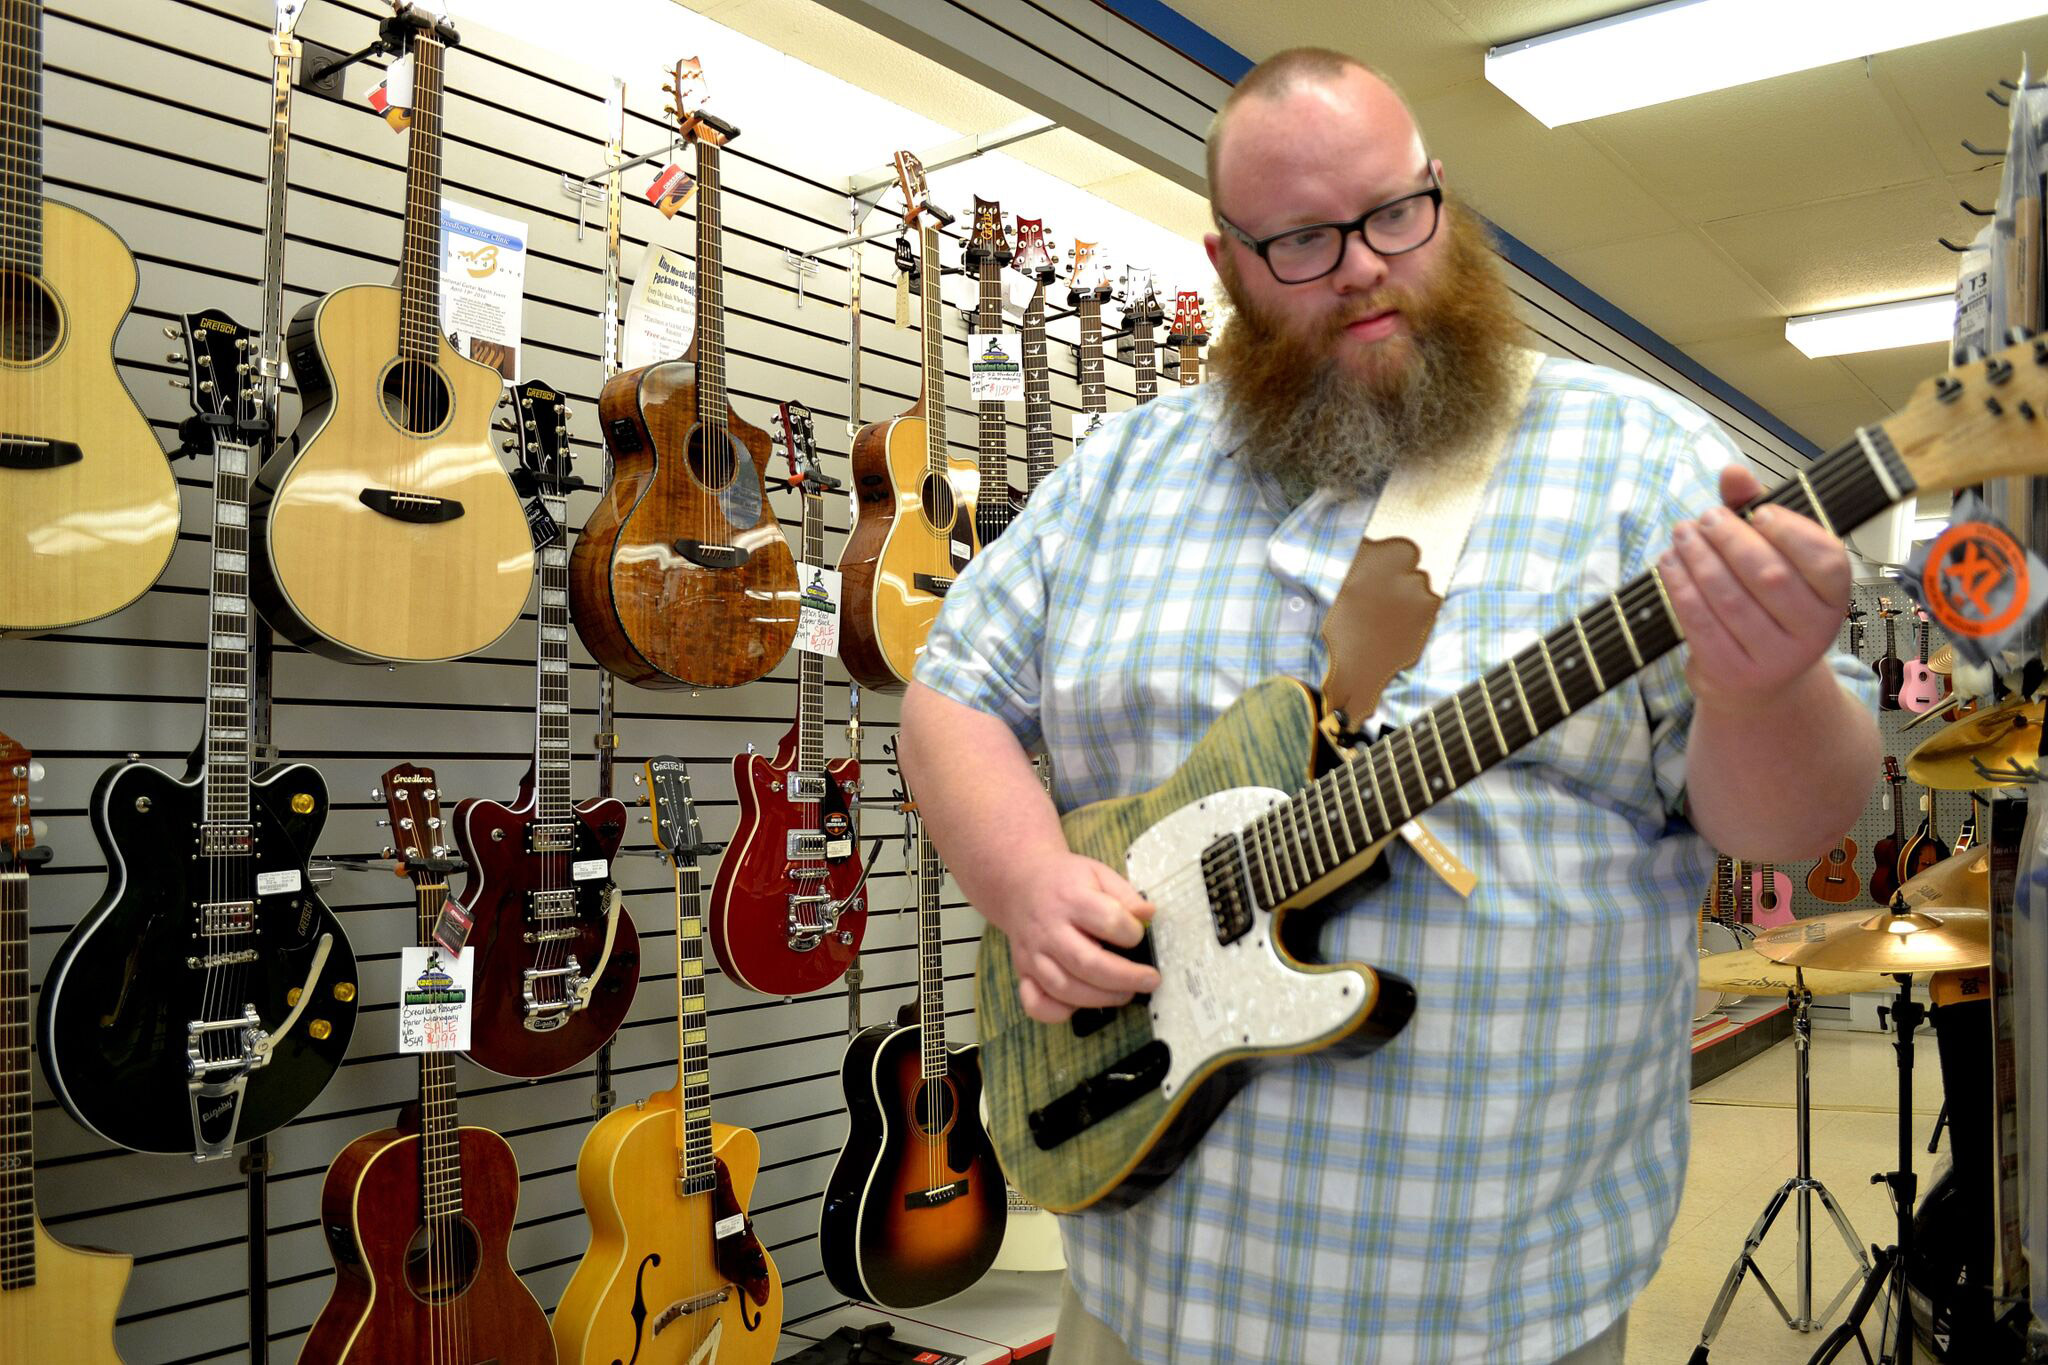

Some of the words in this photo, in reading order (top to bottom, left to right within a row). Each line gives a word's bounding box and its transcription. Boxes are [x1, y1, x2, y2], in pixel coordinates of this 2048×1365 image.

[441, 220, 469, 232] reedlove
[469, 226, 490, 239] Guitar
[490, 234, 510, 244] Clinic
[658, 254, 671, 273] King
[670, 265, 688, 280] Music
[653, 271, 679, 287] Package
[1968, 271, 1987, 291] T3
[200, 317, 237, 335] GRETSCH
[526, 387, 556, 401] GRETSCH
[814, 624, 835, 638] SALE
[393, 773, 433, 784] Breedlove
[298, 899, 314, 937] GRETSCH
[424, 1020, 458, 1034] SALE
[403, 1035, 424, 1047] $549
[427, 1032, 457, 1049] $499
